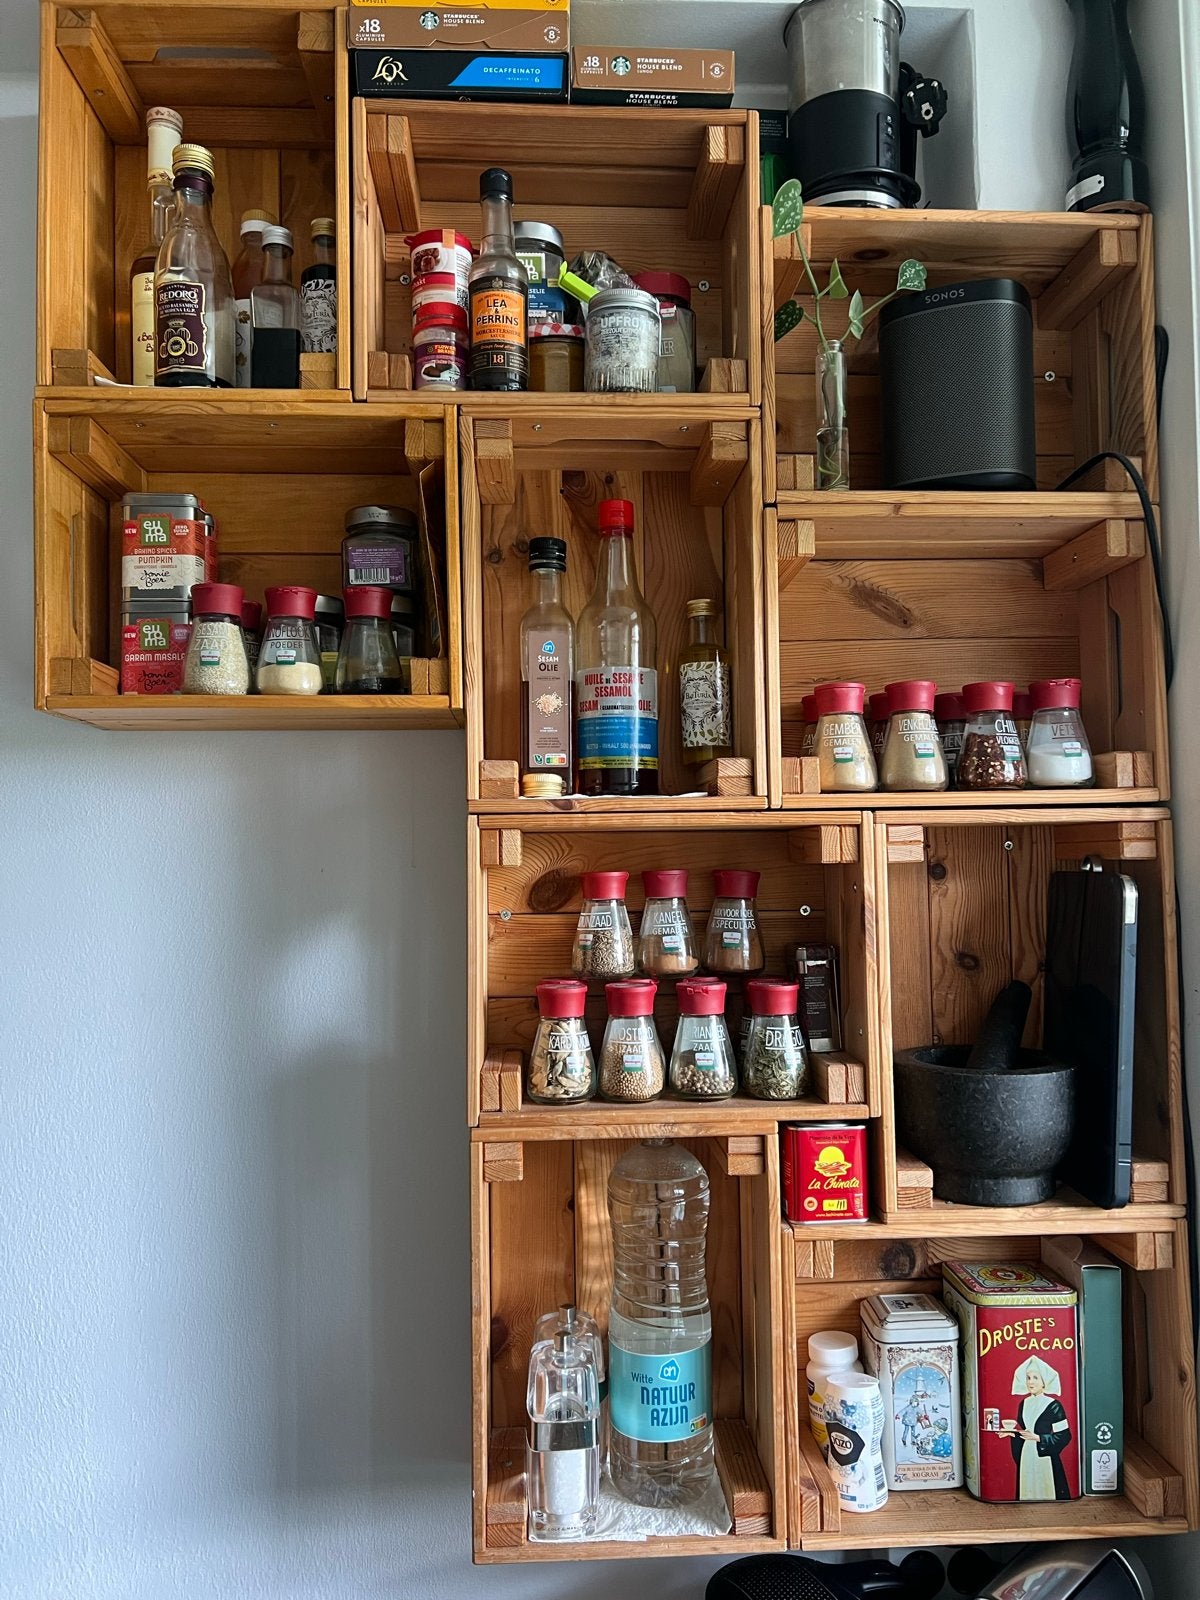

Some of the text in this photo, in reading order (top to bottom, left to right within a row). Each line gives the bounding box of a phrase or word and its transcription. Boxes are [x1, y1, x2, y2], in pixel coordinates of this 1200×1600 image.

[549, 30, 555, 40] 8
[714, 66, 720, 75] 8
[925, 288, 965, 304] SONOS
[486, 298, 507, 308] LEA
[476, 314, 519, 326] PERRINS
[492, 354, 504, 364] 18
[194, 638, 228, 651] ZAAD
[124, 653, 152, 662] GARAM
[538, 663, 559, 672] OLIE
[584, 673, 604, 686] HUILE
[594, 684, 632, 698] SESAMÖL
[580, 700, 599, 713] SESAM
[638, 700, 652, 712] OLIE
[823, 722, 863, 736] GEMBER
[652, 910, 686, 925] KANEEL
[723, 908, 739, 918] VOOR
[716, 920, 756, 930] SPECULAAS
[807, 1176, 860, 1190] La Chinata
[978, 1317, 1056, 1357] DROSTE'S
[1015, 1336, 1074, 1351] CACAO
[631, 1371, 654, 1384] Witte
[640, 1382, 696, 1406] NATUUR
[650, 1405, 689, 1427] AZIJN
